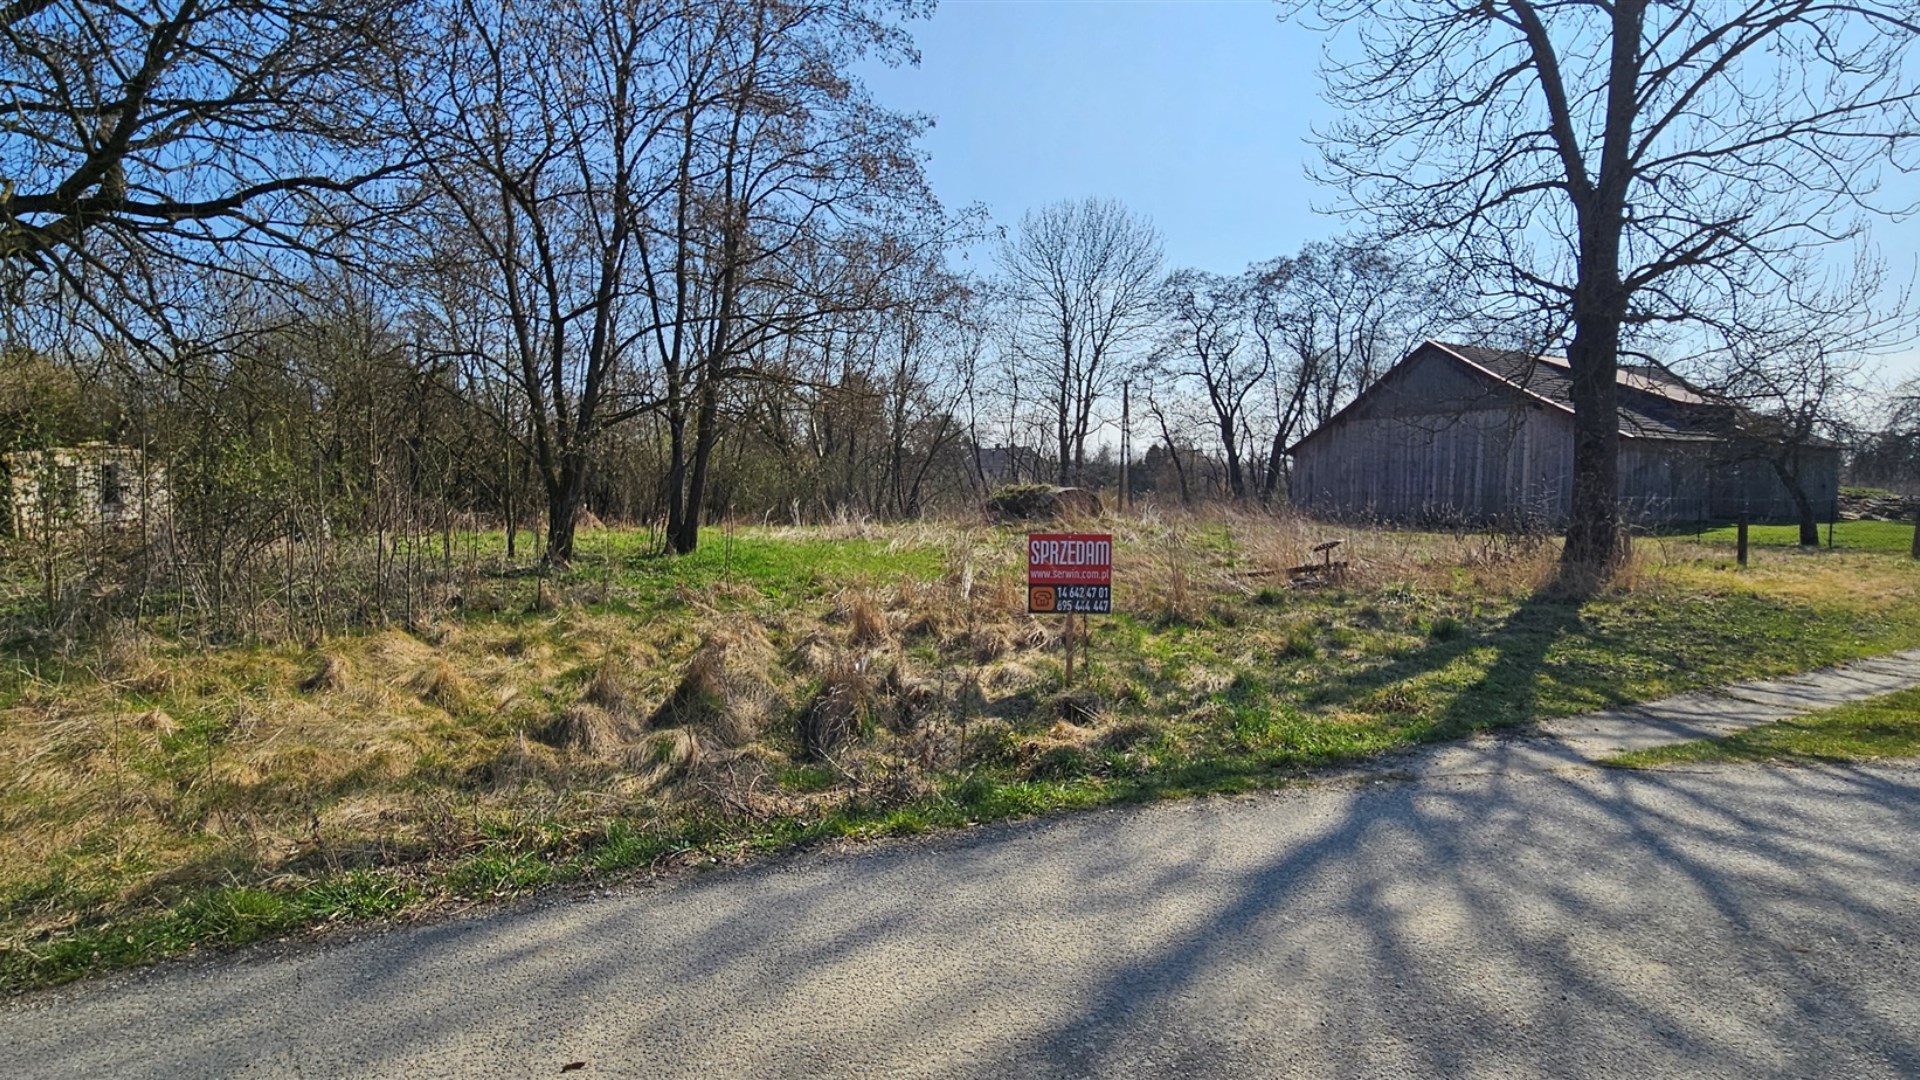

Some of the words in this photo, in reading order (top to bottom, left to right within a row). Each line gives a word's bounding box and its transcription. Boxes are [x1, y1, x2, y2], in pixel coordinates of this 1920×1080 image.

[1030, 540, 1110, 565] SPRZEDAM
[1030, 569, 1110, 581] www.serwin.com.pl
[1057, 586, 1068, 598] 14
[1069, 586, 1085, 598] 642
[1086, 586, 1097, 598] 47
[1098, 586, 1108, 598] 01
[1056, 600, 1072, 611] 695
[1074, 600, 1091, 611] 444
[1093, 600, 1109, 611] 447
